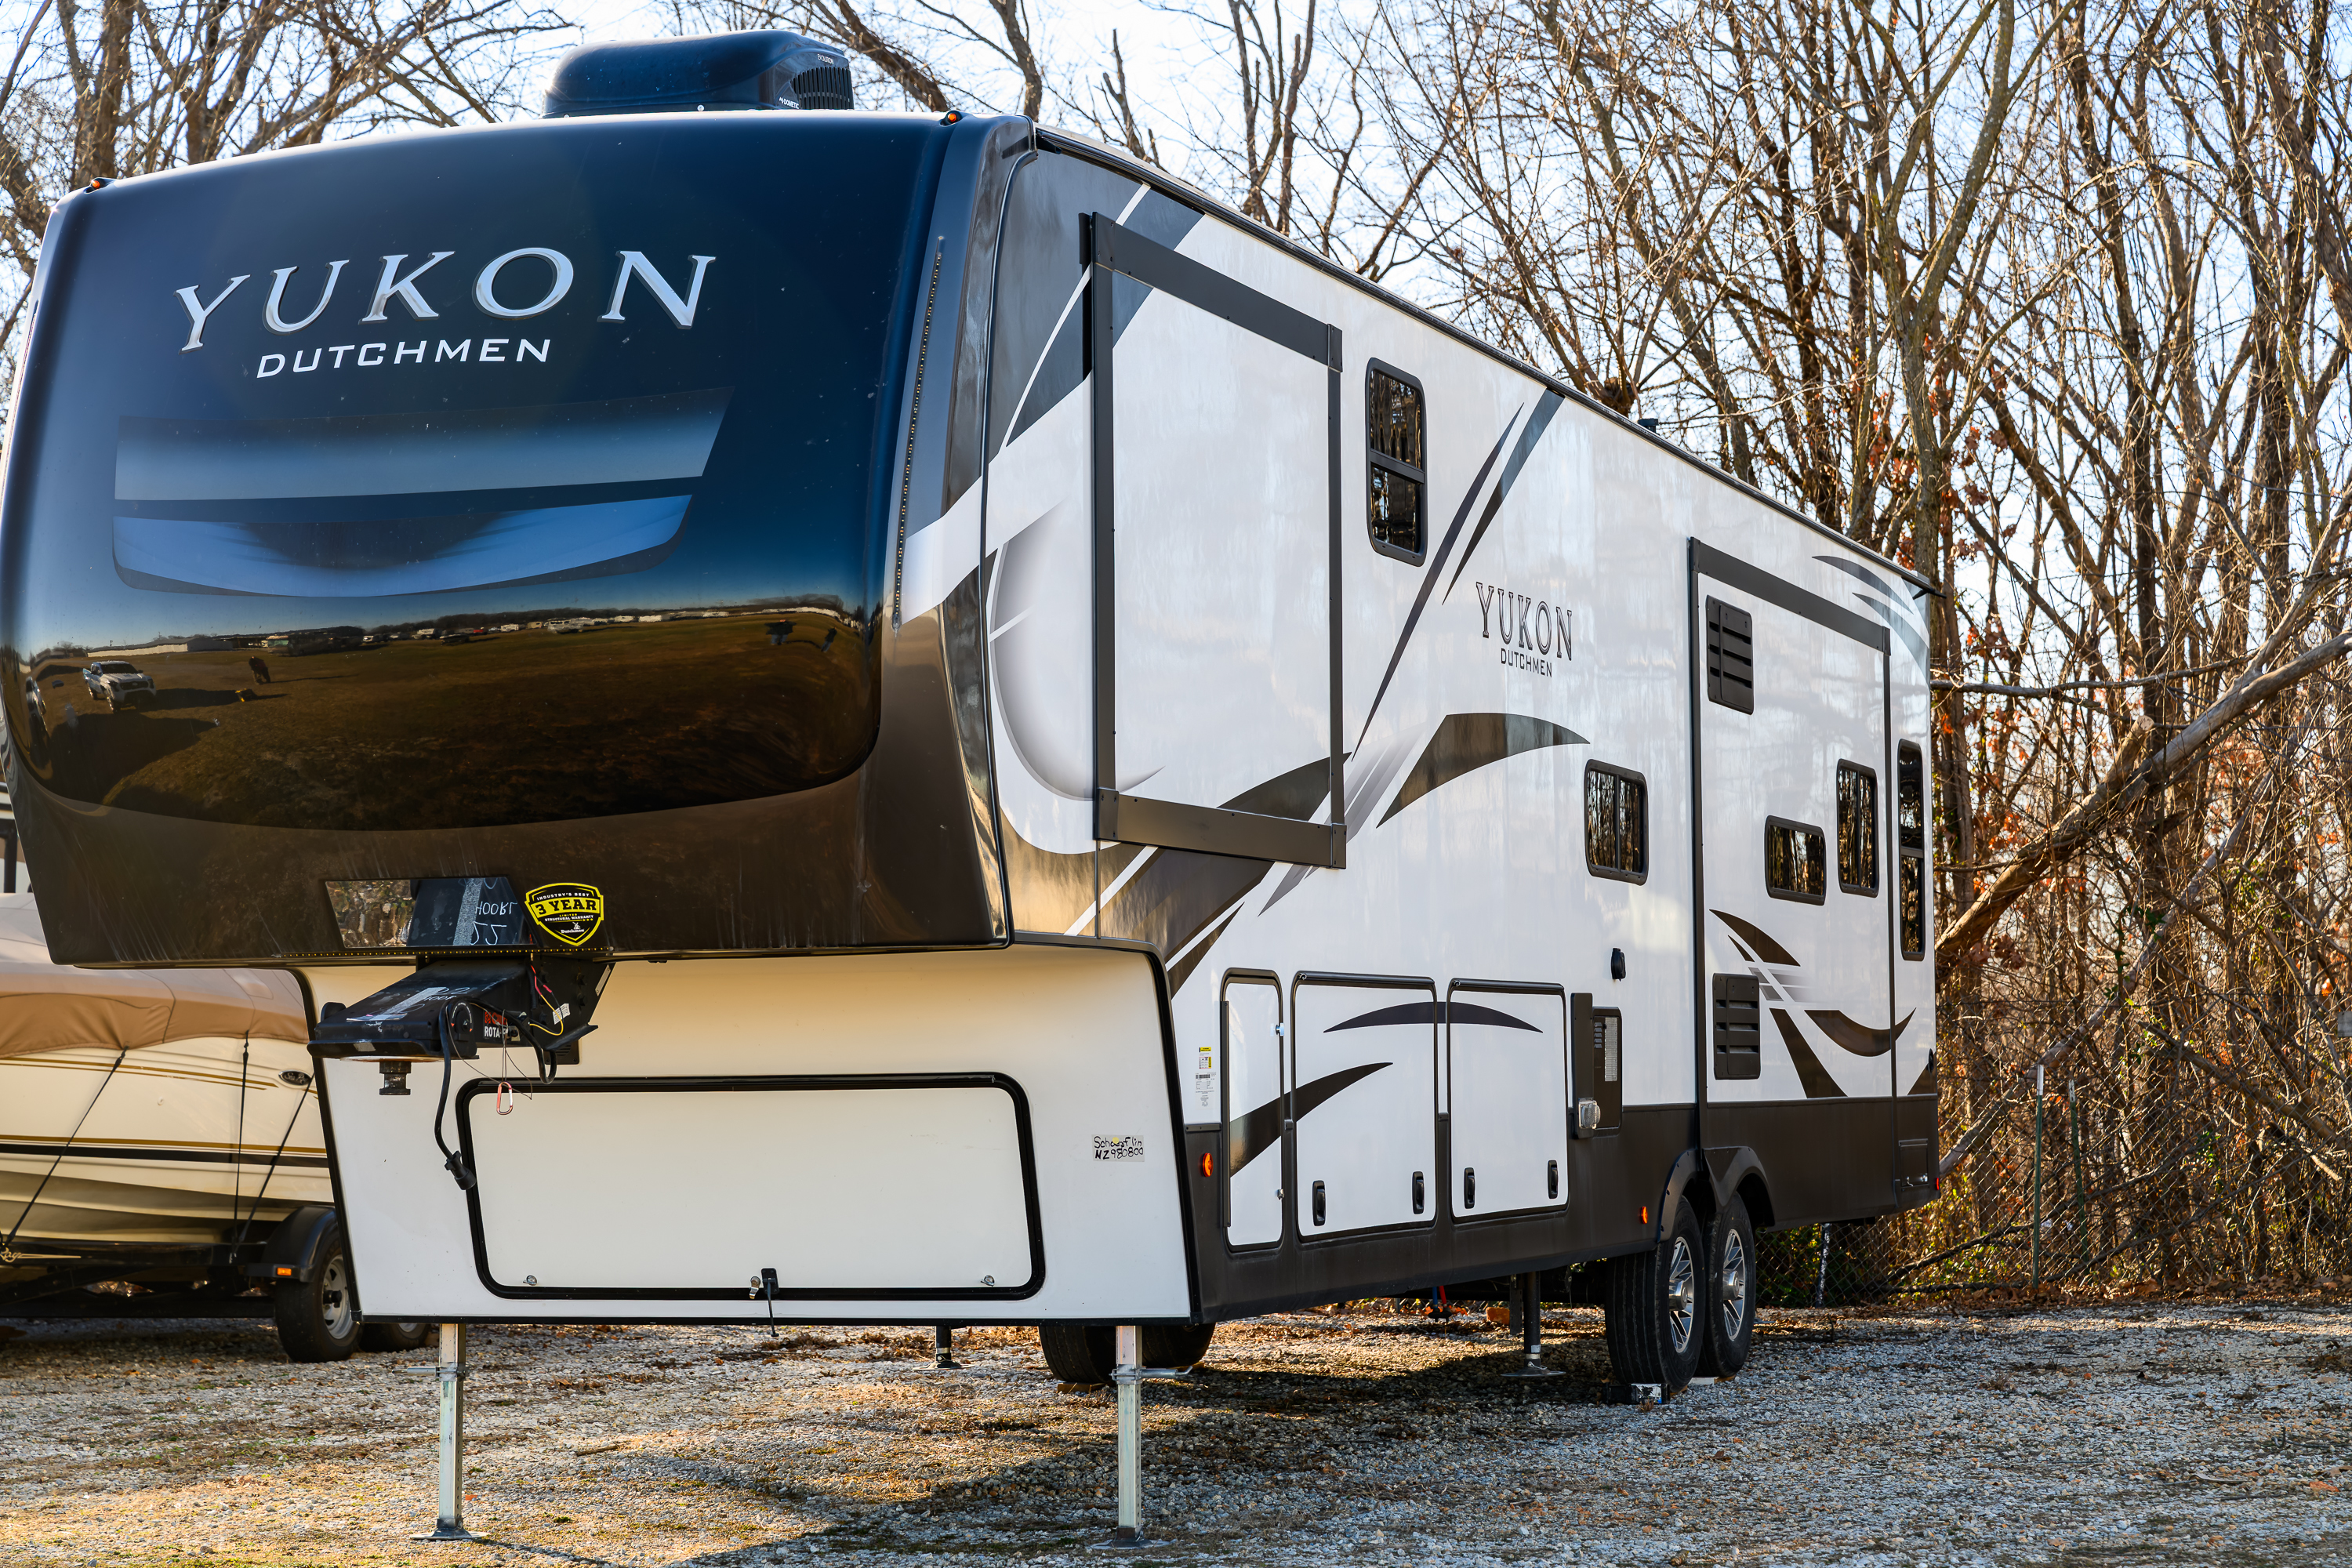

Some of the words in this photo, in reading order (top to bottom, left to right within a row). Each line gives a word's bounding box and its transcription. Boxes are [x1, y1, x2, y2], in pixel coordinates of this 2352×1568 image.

[783, 98, 800, 110] DOMETIC
[173, 247, 717, 354] YUKON
[256, 338, 550, 378] DUTCHMEN
[1475, 581, 1572, 661] YUKON
[1501, 648, 1552, 678] DUTCHMEN
[535, 903, 547, 915] 3
[548, 898, 597, 912] YEAR
[536, 892, 572, 901] INDUSTRY'S
